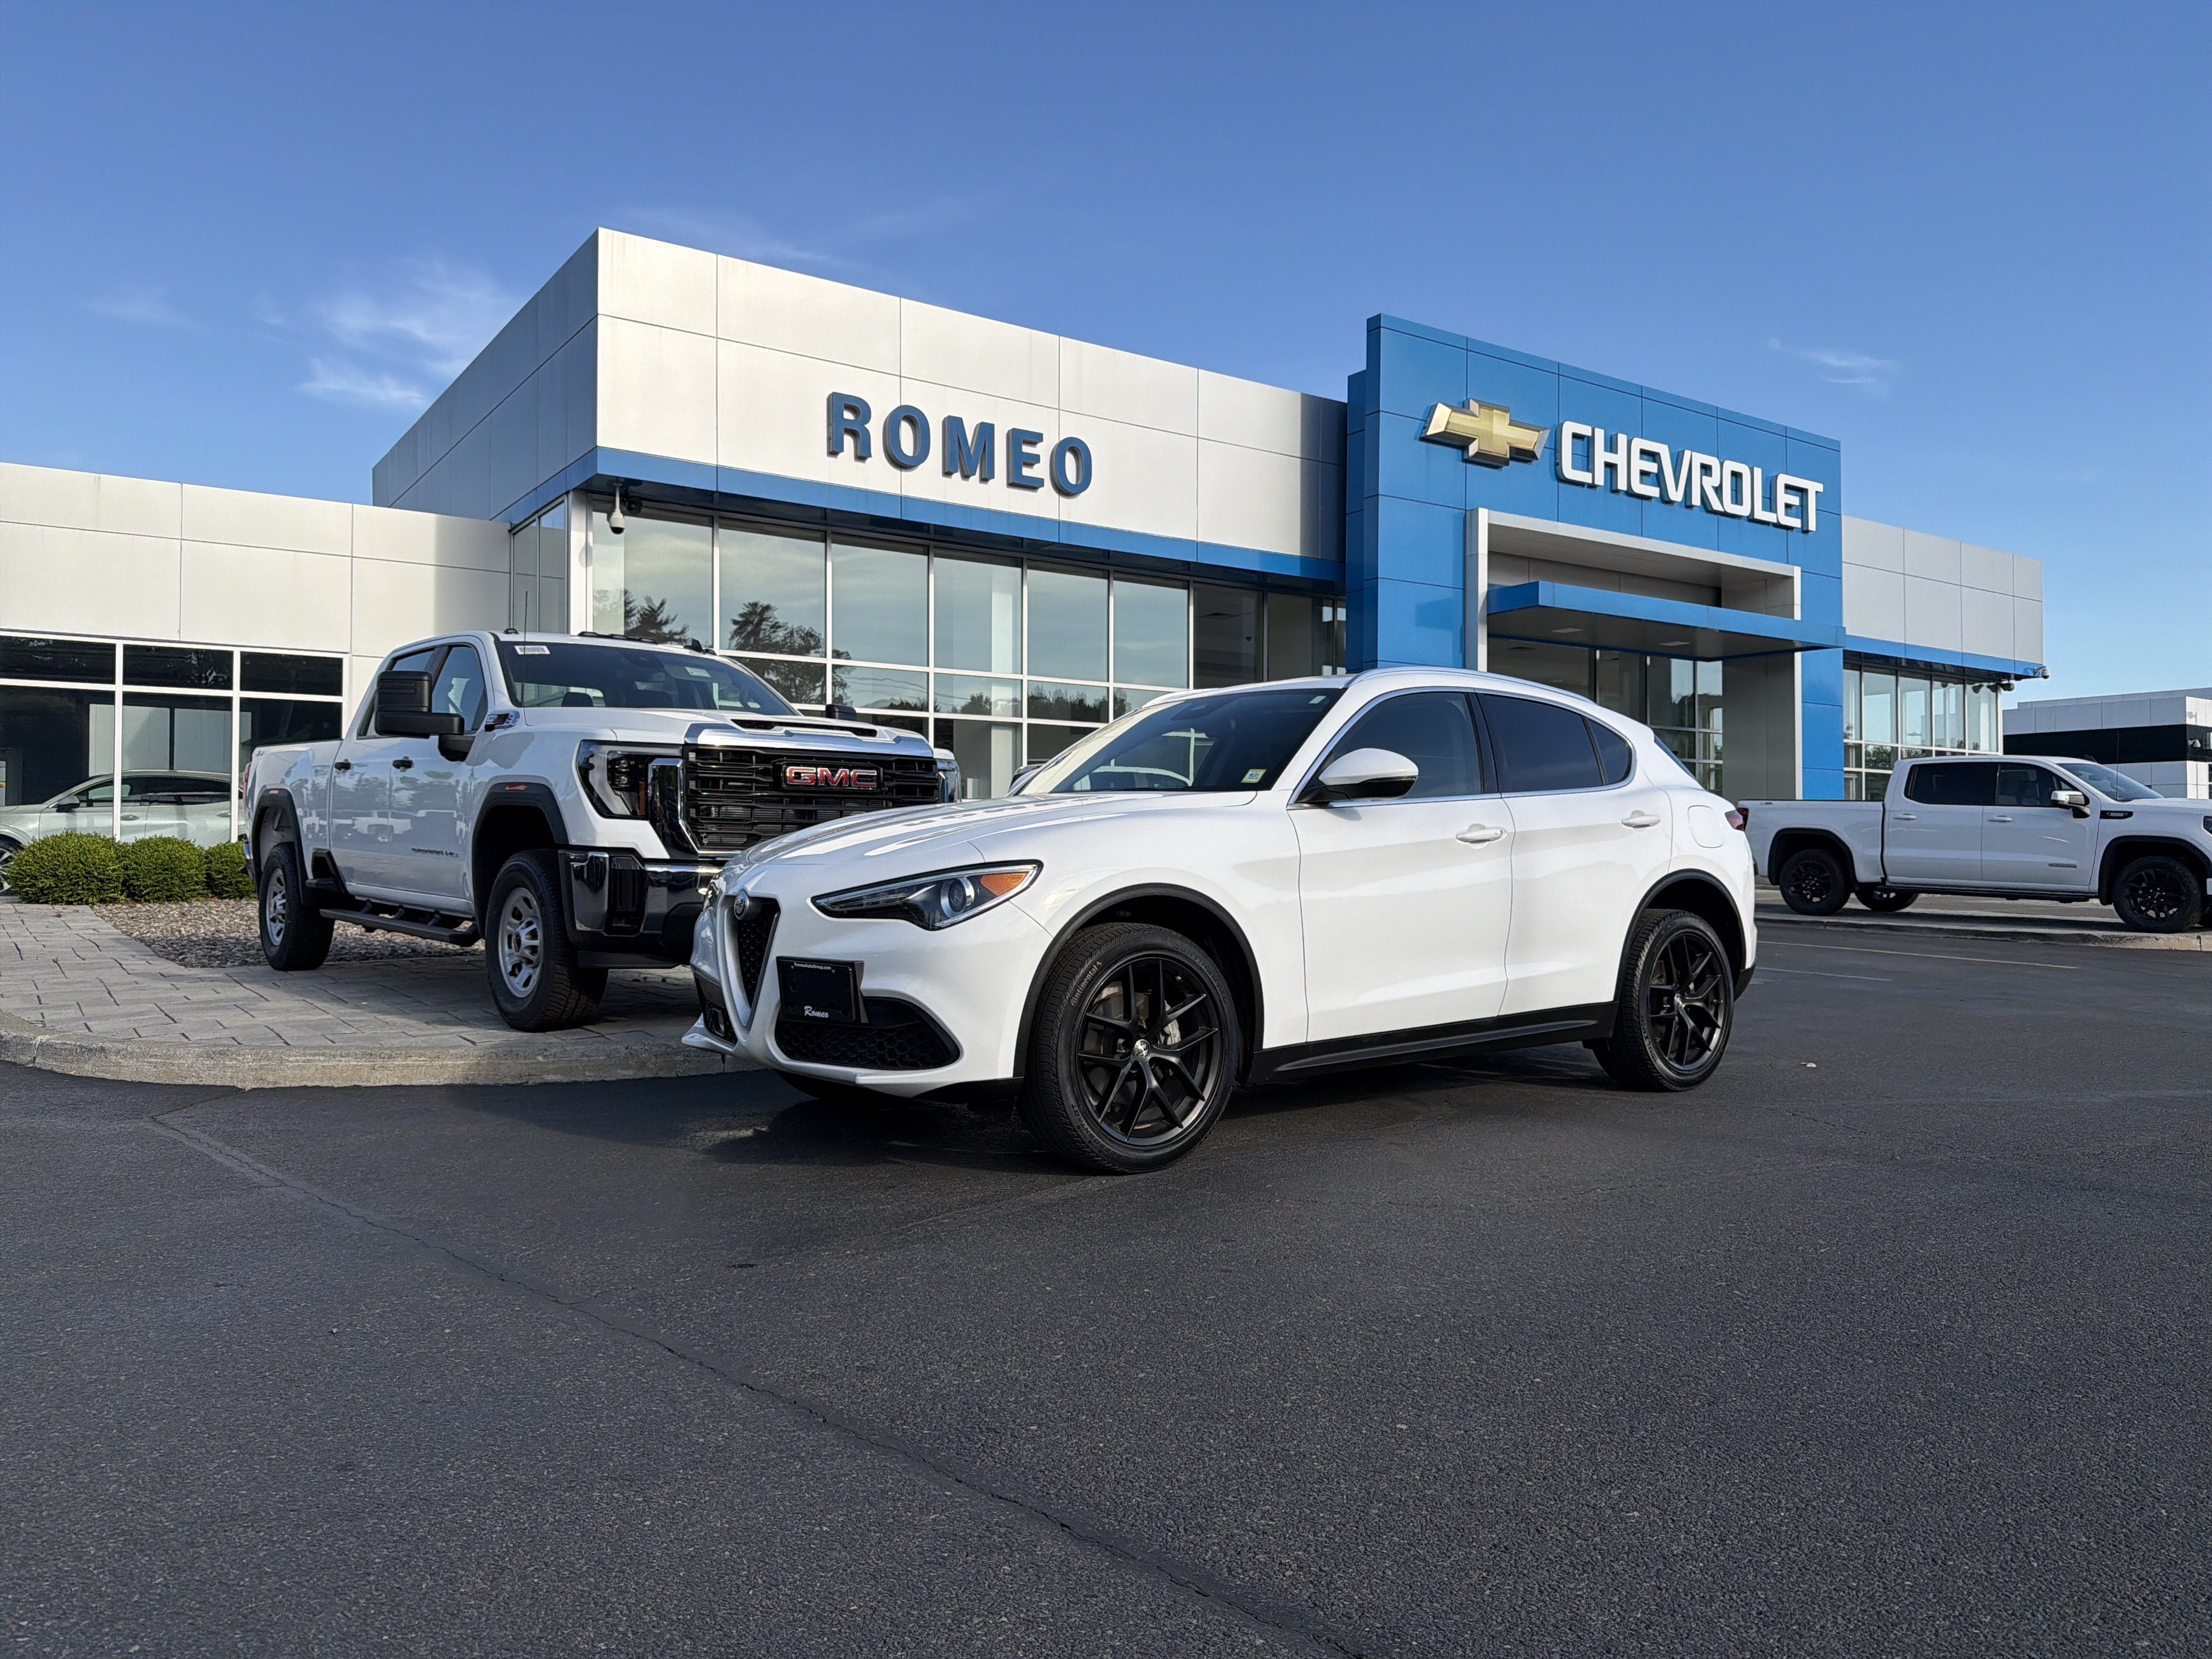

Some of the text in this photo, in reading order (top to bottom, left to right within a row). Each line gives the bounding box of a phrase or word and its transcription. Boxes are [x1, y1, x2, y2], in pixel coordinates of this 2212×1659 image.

[827, 392, 1092, 495] ROMEO
[1557, 421, 1823, 532] CHEVROLET
[786, 766, 877, 788] GMC
[1071, 964, 1098, 1006] Continental
[804, 1006, 829, 1018] Romeo
